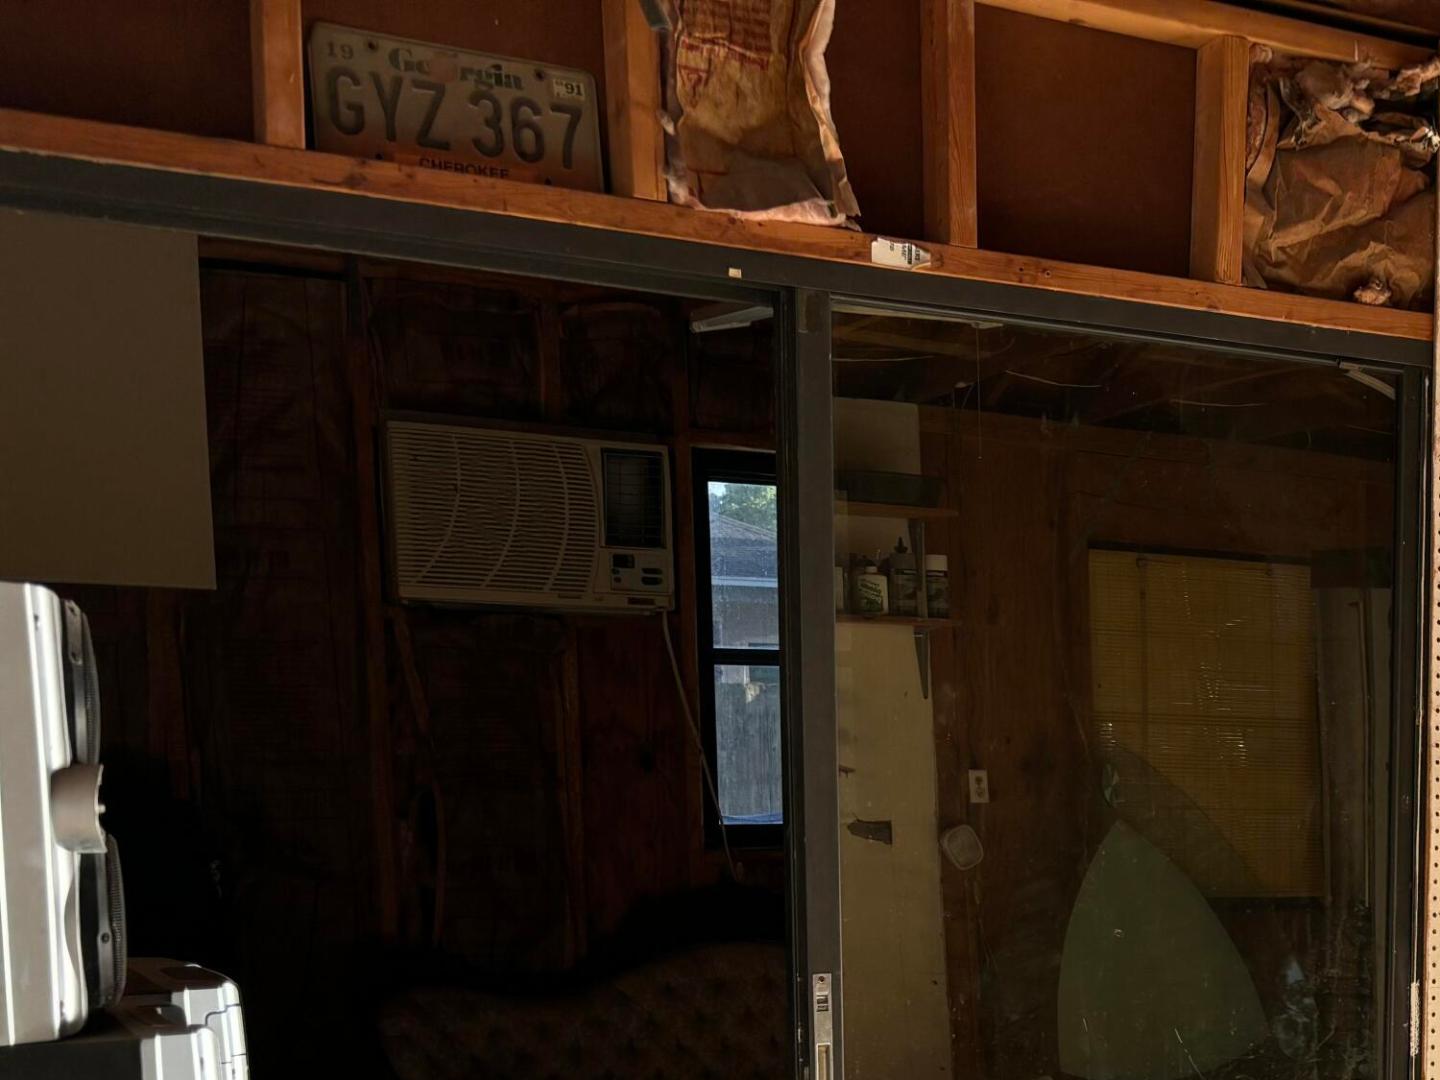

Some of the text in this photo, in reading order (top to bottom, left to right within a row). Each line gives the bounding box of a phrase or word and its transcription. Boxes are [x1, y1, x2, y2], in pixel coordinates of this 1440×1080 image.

[327, 41, 353, 60] 19
[565, 82, 583, 97] 91
[325, 65, 583, 170] GYZ 367
